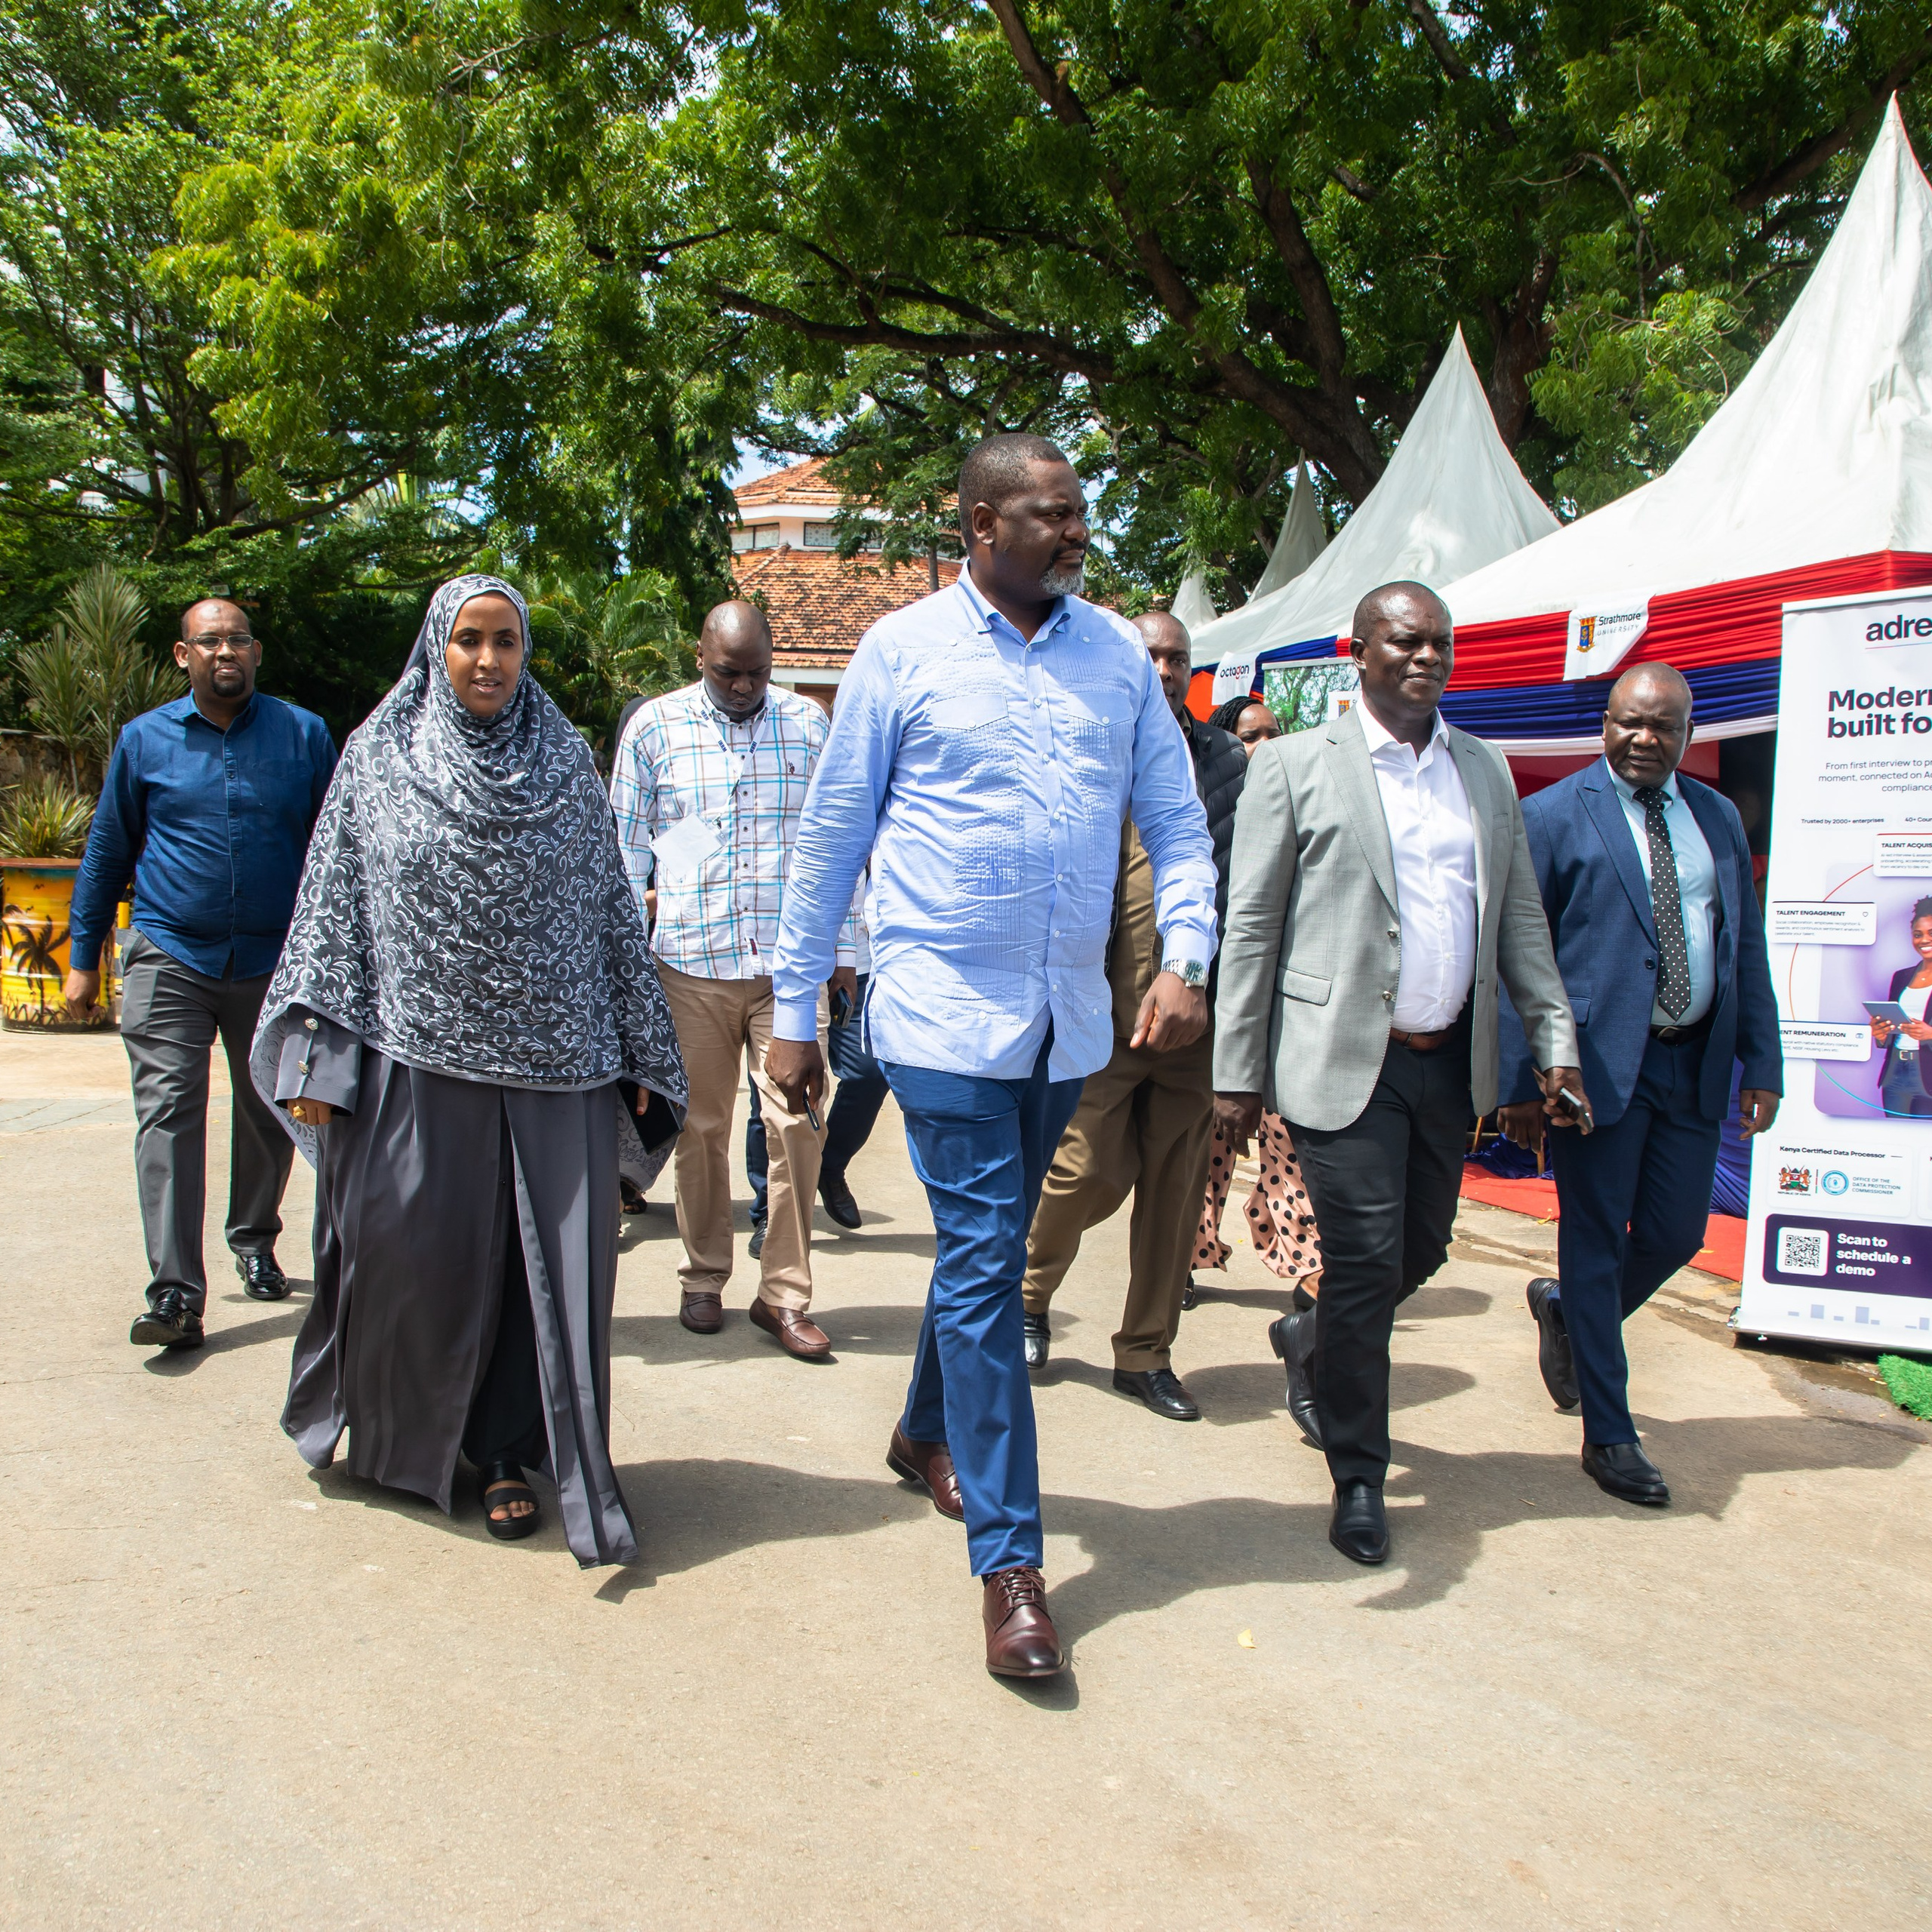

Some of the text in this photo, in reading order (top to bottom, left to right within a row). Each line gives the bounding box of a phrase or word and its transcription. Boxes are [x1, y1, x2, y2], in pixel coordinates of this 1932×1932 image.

[1598, 613, 1641, 626] Strathmore
[1597, 624, 1639, 636] UNIVERSITY
[1866, 614, 1932, 641] adre
[1220, 665, 1250, 679] octagon
[1827, 712, 1932, 738] built fo
[1869, 759, 1911, 768] interview
[1860, 771, 1909, 781] connected
[1881, 783, 1932, 793] compliance
[1780, 1146, 1801, 1154] Kenya
[1801, 1147, 1832, 1155] Certified
[1837, 1233, 1888, 1247] Scan to
[1836, 1250, 1912, 1265] schedule a
[1835, 1263, 1876, 1276] demo
